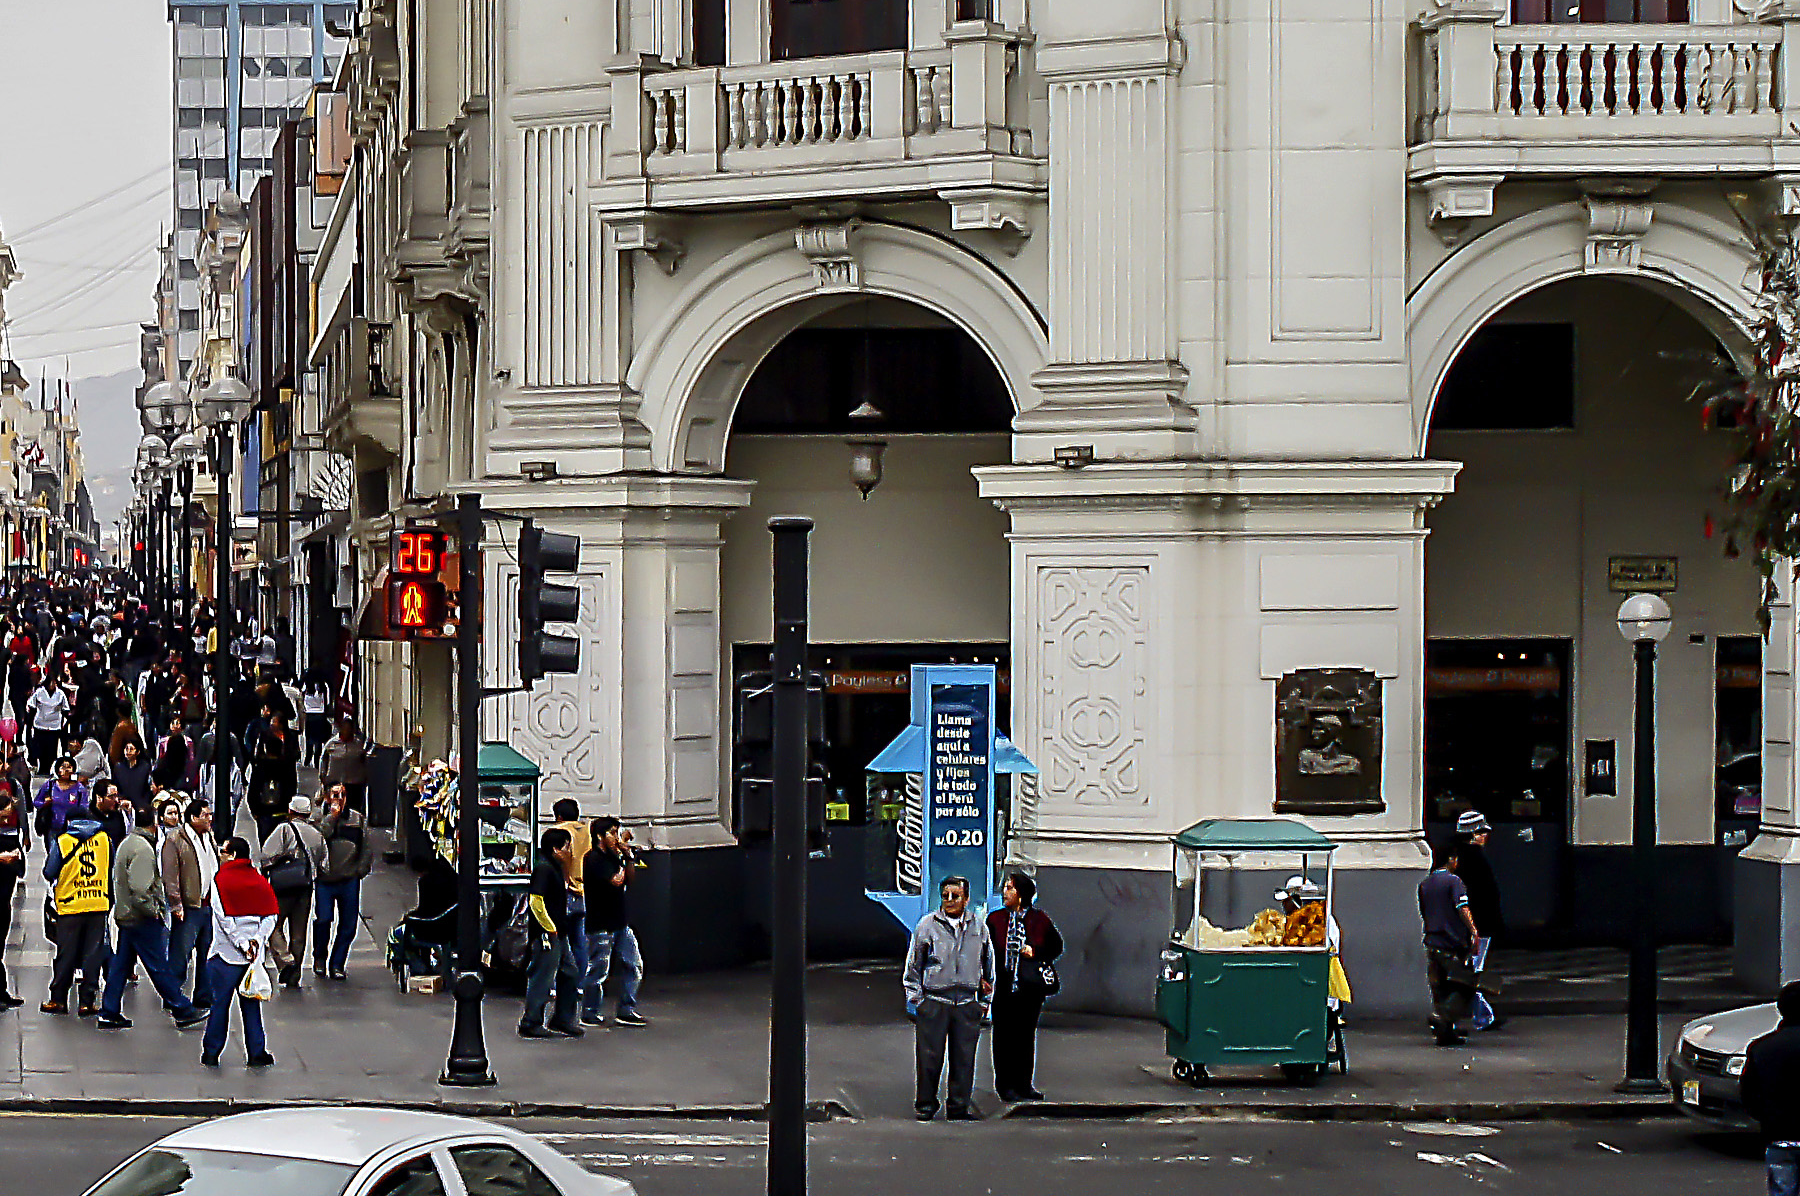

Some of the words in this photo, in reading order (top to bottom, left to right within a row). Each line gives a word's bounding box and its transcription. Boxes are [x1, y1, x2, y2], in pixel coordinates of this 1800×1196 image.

[398, 533, 435, 573] 26
[937, 713, 972, 725] Llama
[936, 726, 970, 738] desde
[962, 742, 971, 751] a
[936, 753, 987, 765] celulares
[936, 767, 944, 779] y
[936, 779, 950, 791] de
[951, 779, 977, 791] todo
[935, 792, 946, 804] el
[948, 792, 974, 804] Perú
[935, 806, 954, 819] por
[956, 805, 980, 817] sólo
